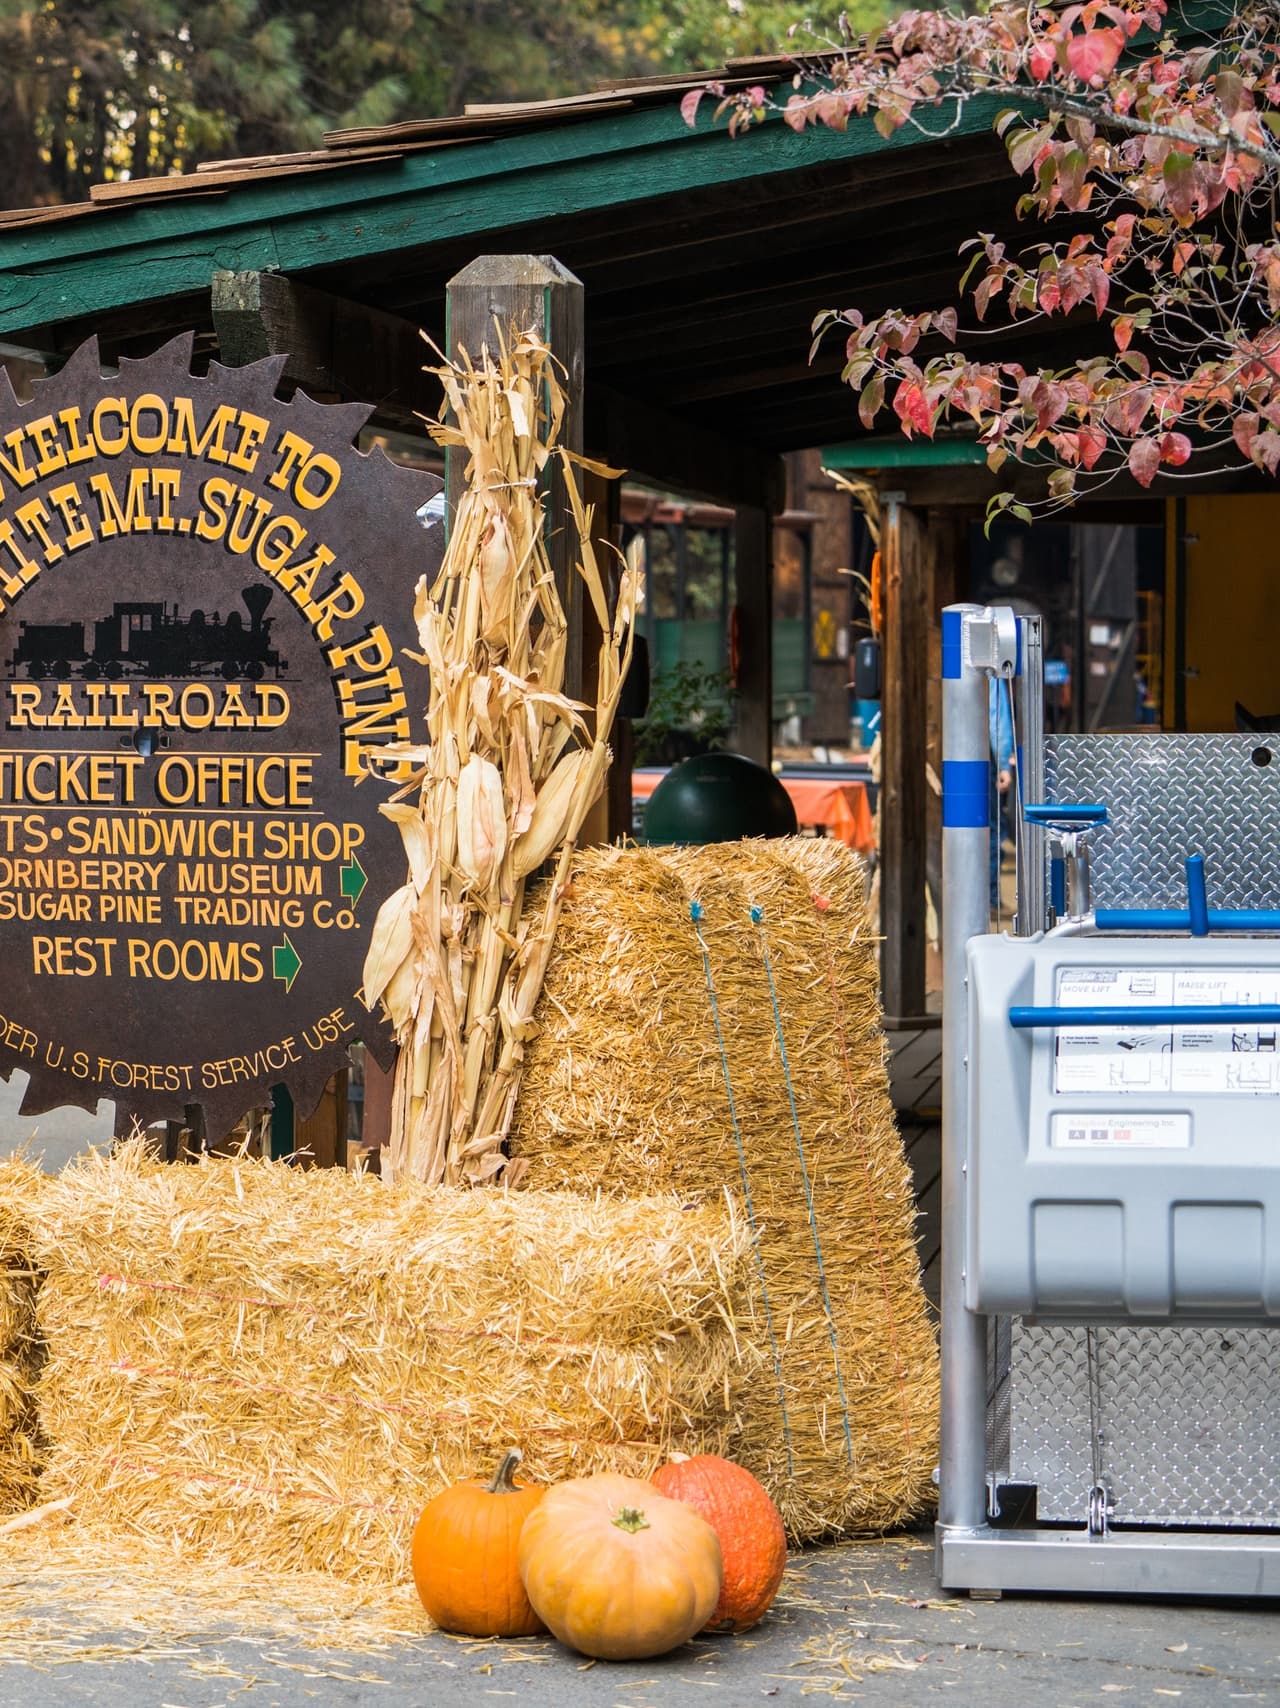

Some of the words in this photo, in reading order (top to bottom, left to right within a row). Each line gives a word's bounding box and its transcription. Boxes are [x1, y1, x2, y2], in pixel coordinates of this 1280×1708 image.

[268, 431, 341, 510] TO
[90, 468, 192, 538] MT.
[197, 478, 365, 643] SUGAR
[328, 625, 413, 779] PINE
[9, 683, 291, 728] RAILROAD
[157, 756, 314, 806] OFFICE
[264, 821, 365, 861] SHOP
[177, 862, 322, 896] MUSEUM
[99, 894, 162, 923] PINE
[175, 896, 304, 928] TRADING
[312, 900, 361, 929] Co.
[33, 936, 117, 976] REST
[128, 939, 264, 983] ROOMS
[1063, 985, 1090, 993] MOVE
[1091, 985, 1112, 993] LIFT
[1208, 982, 1228, 990] LIFT
[98, 1057, 192, 1091] FOREST
[202, 1037, 302, 1089] SERVICE
[303, 1008, 353, 1051] USE
[1108, 1119, 1160, 1128] Engineering
[1161, 1119, 1177, 1127] Inc.
